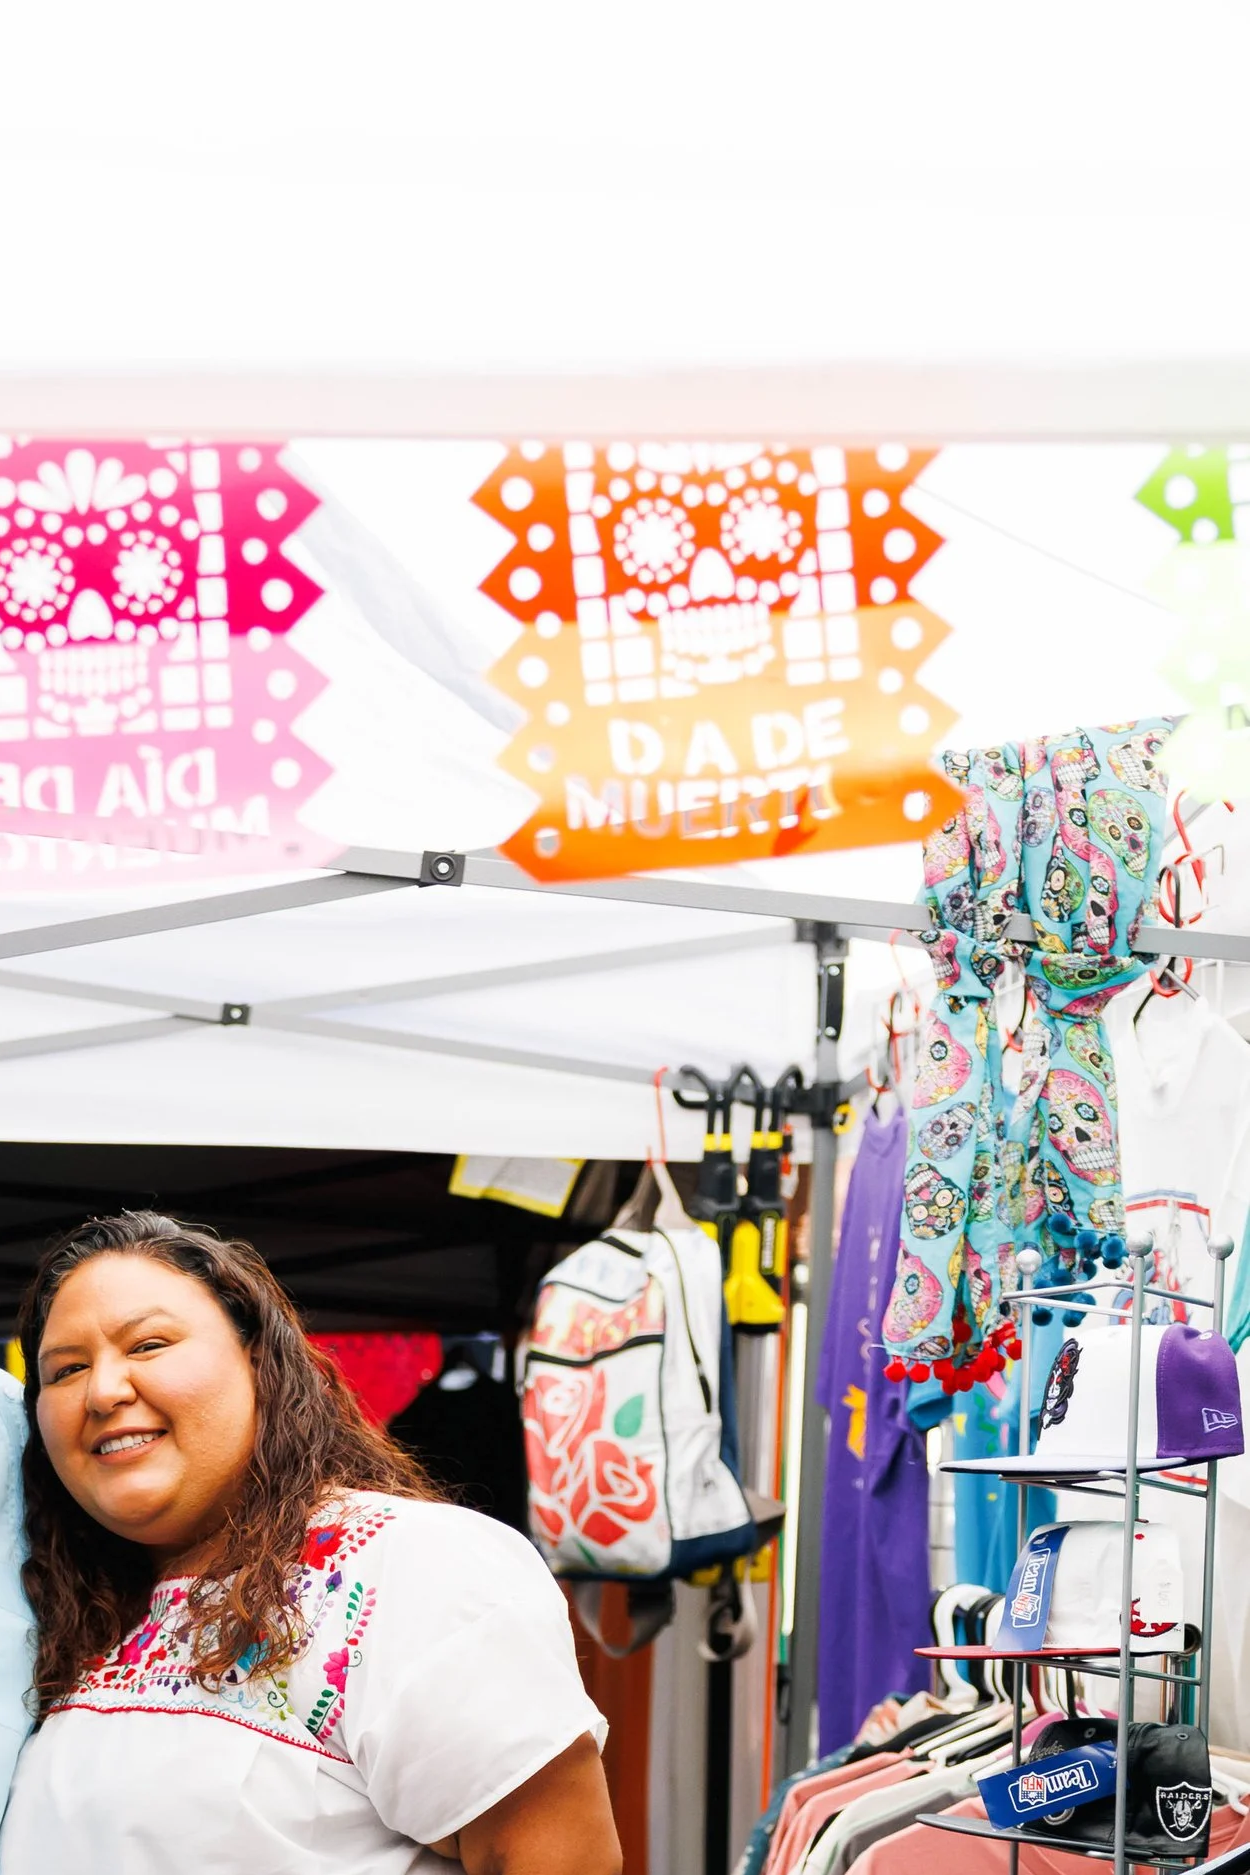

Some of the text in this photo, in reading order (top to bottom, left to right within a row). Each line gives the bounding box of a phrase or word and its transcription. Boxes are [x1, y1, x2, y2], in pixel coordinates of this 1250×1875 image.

[751, 697, 850, 770] DE
[1022, 1553, 1047, 1594] Team
[1046, 1766, 1092, 1793] Team
[1160, 1791, 1210, 1801] RAIDERS
